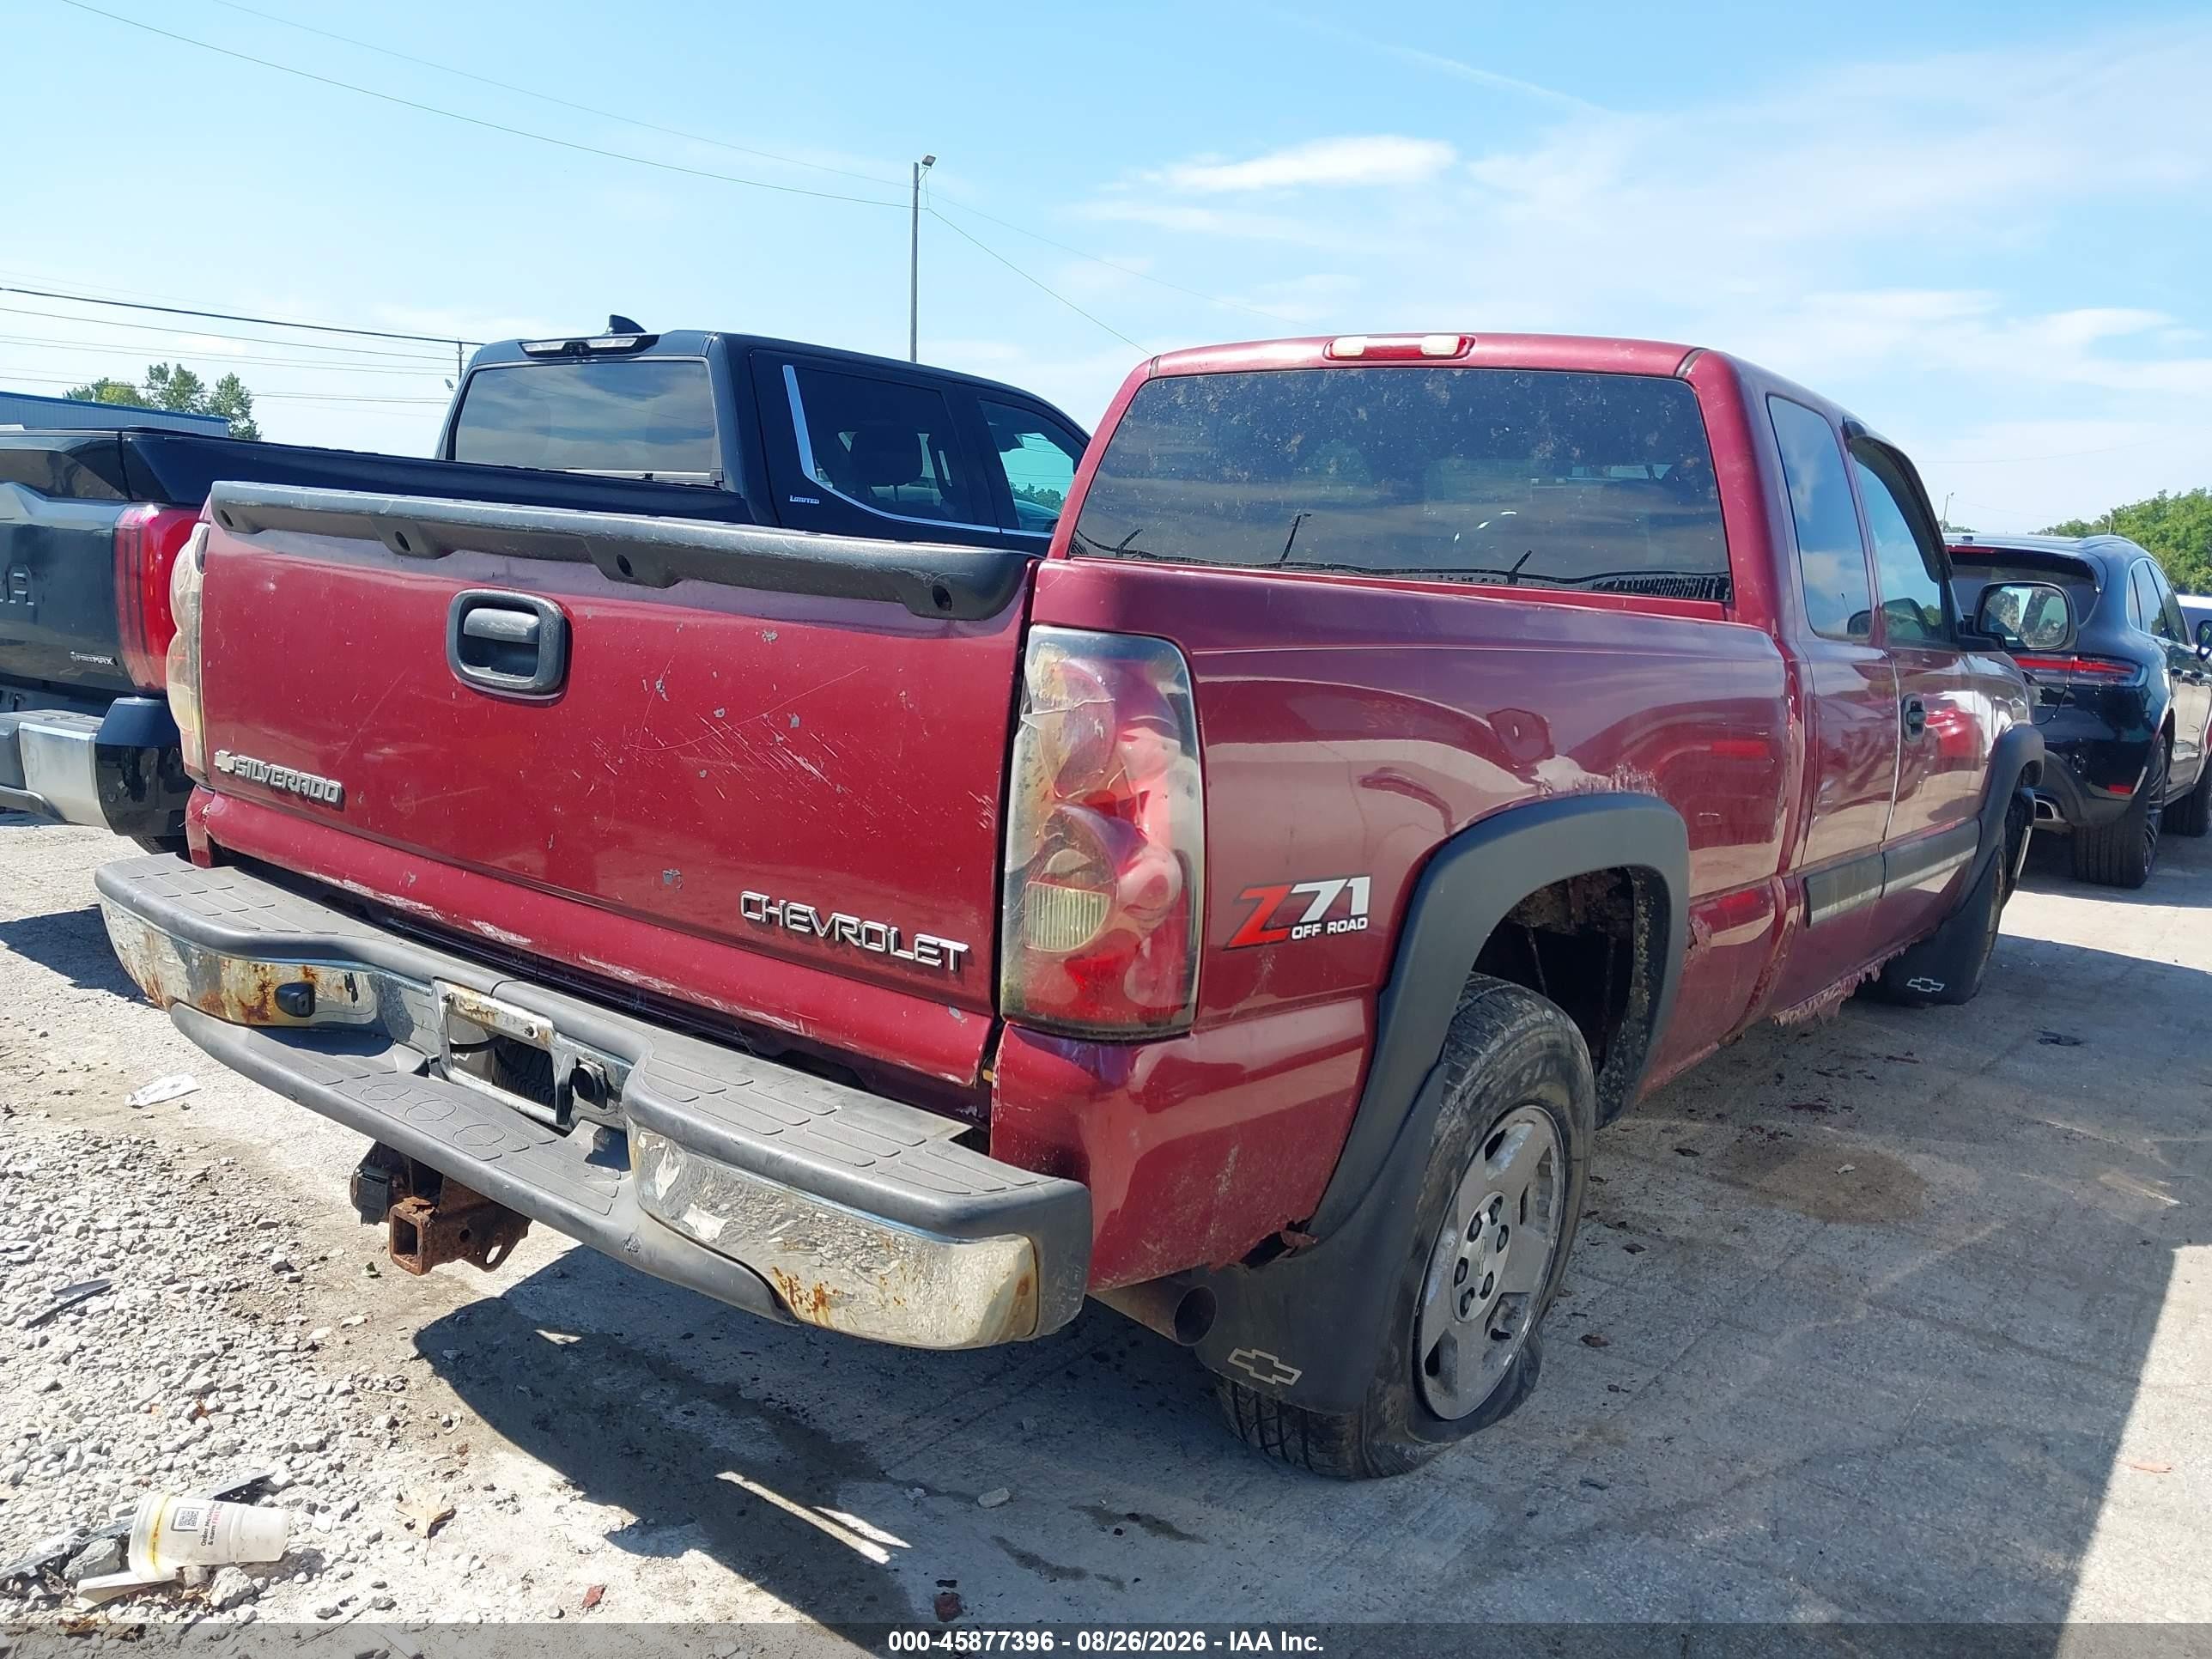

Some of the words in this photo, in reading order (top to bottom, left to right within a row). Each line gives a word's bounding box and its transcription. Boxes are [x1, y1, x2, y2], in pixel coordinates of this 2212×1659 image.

[789, 495, 820, 504] LIMITED
[234, 755, 343, 803] SILVERADO
[1226, 876, 1371, 949] Z71
[1291, 922, 1322, 940] OFF
[1327, 916, 1369, 935] ROAD
[741, 890, 969, 972] CHEVROLET
[200, 1528, 209, 1547] Order
